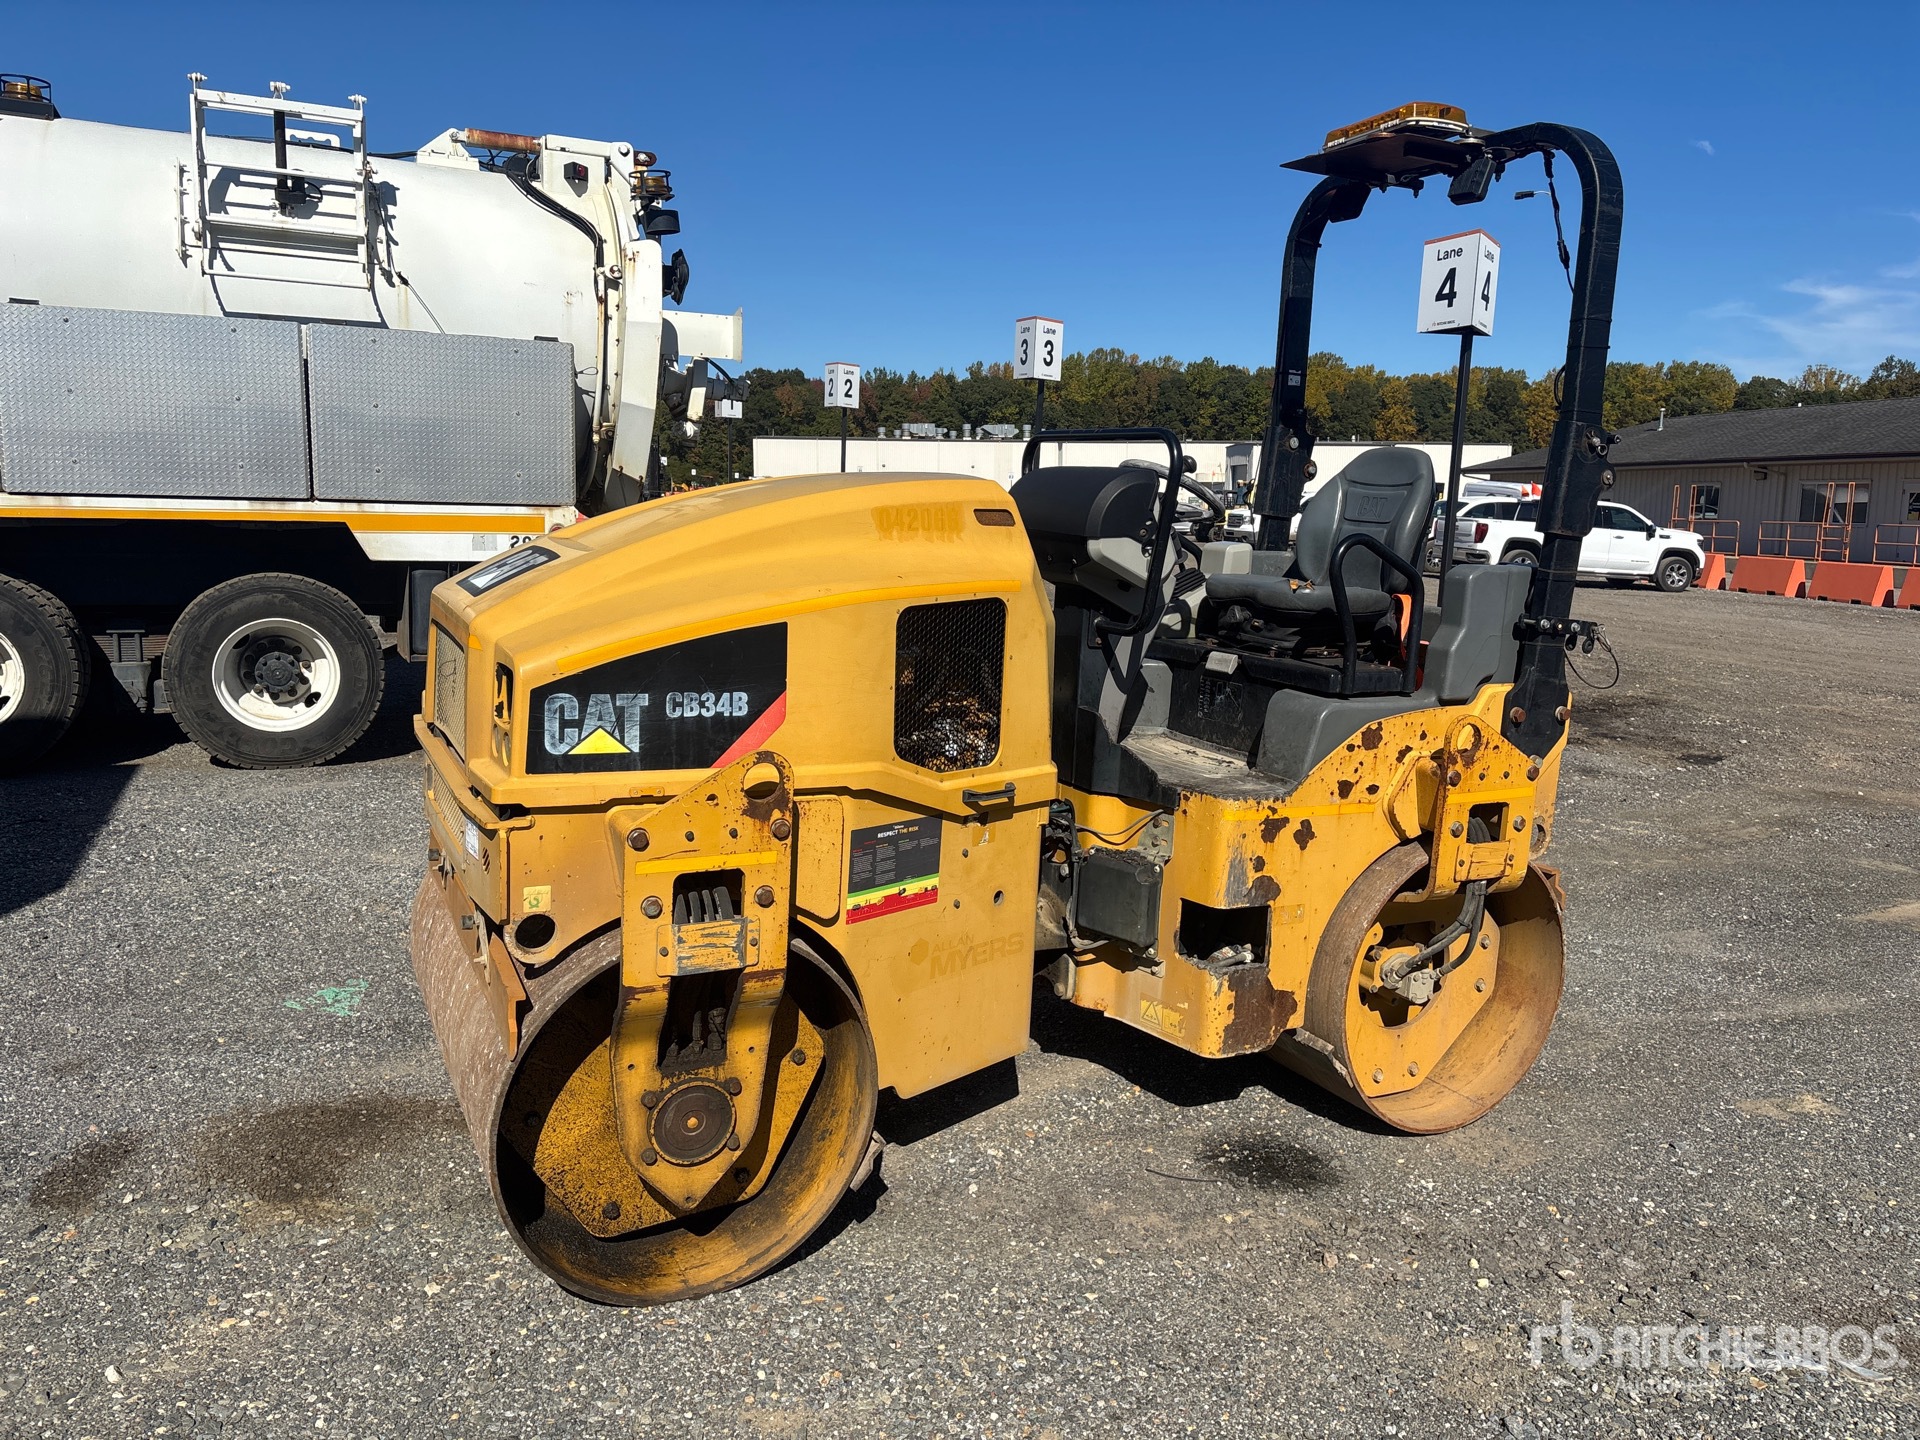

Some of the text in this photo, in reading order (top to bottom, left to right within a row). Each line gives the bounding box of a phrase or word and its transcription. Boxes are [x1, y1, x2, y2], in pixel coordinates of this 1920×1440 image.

[1437, 247, 1463, 261] Lane
[1484, 245, 1494, 263] Lane
[1435, 267, 1457, 308] 4
[1481, 271, 1491, 311] 4
[1020, 326, 1030, 334] Lane
[1043, 325, 1056, 335] Lane
[1020, 338, 1028, 366] 3
[1043, 339, 1054, 367] 3
[843, 368, 855, 376] Lane
[828, 378, 834, 397] 2
[844, 378, 853, 398] 2
[665, 692, 749, 718] CB34B
[544, 693, 649, 755] CAT
[877, 830, 898, 838] RESPECT
[929, 932, 1025, 980] MYERS
